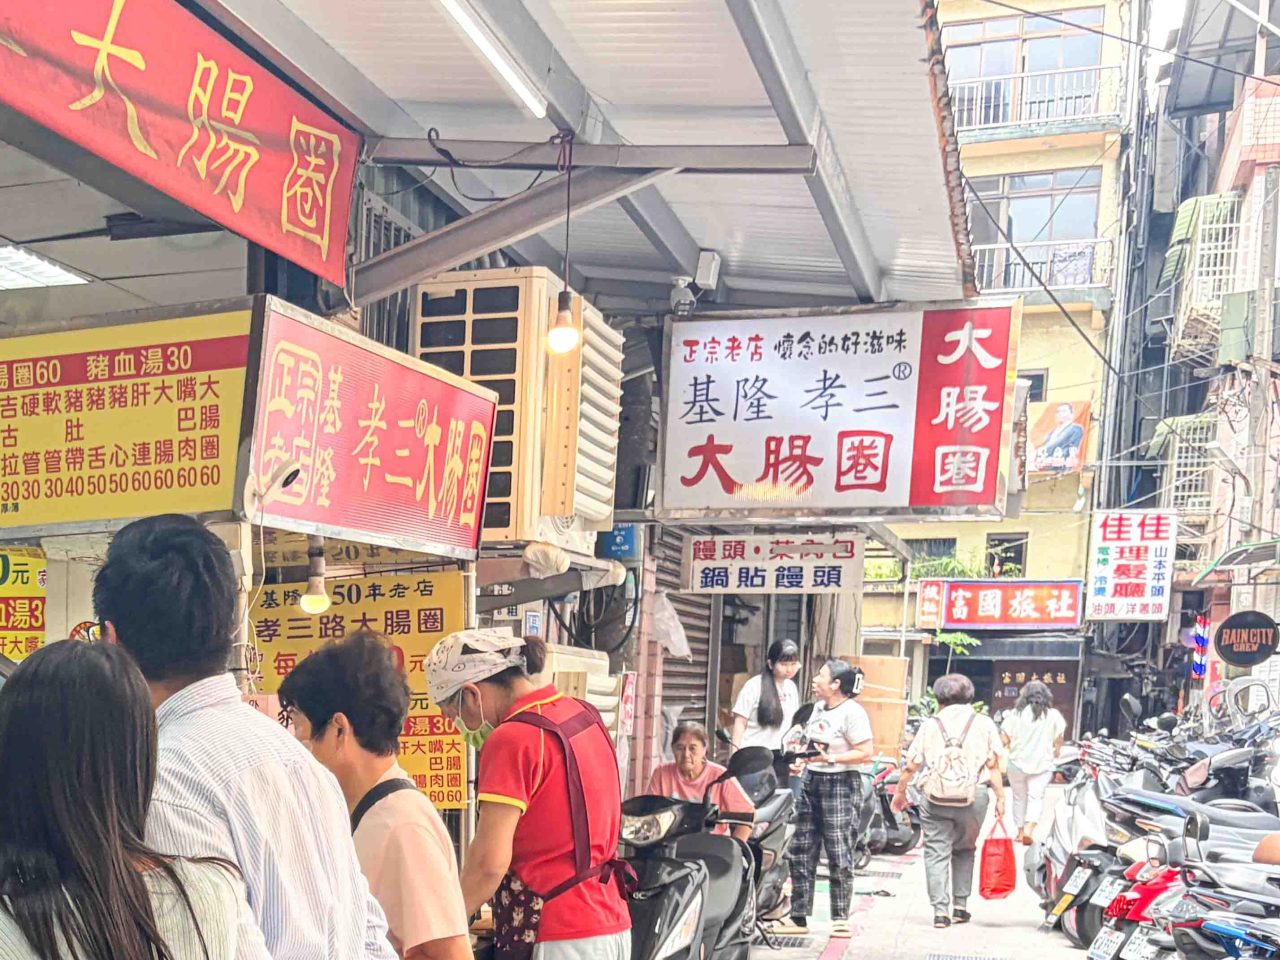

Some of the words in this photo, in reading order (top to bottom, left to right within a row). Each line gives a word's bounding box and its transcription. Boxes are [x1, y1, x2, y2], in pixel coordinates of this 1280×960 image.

[682, 334, 765, 364] 正宗老店
[774, 331, 907, 359] 懷念的好滋味
[679, 375, 778, 424] 基隆
[931, 321, 1003, 494] 大腸圈
[416, 404, 486, 528] 大腸圈
[680, 430, 894, 496] 大腸圈
[1099, 513, 1171, 542] 佳佳
[700, 565, 842, 589] 鍋貼饅頭
[951, 588, 1075, 619] 富國旅社
[255, 607, 444, 643] 孝三路大腸圈
[1222, 629, 1248, 646] RAIN
[1250, 628, 1274, 645] CITY
